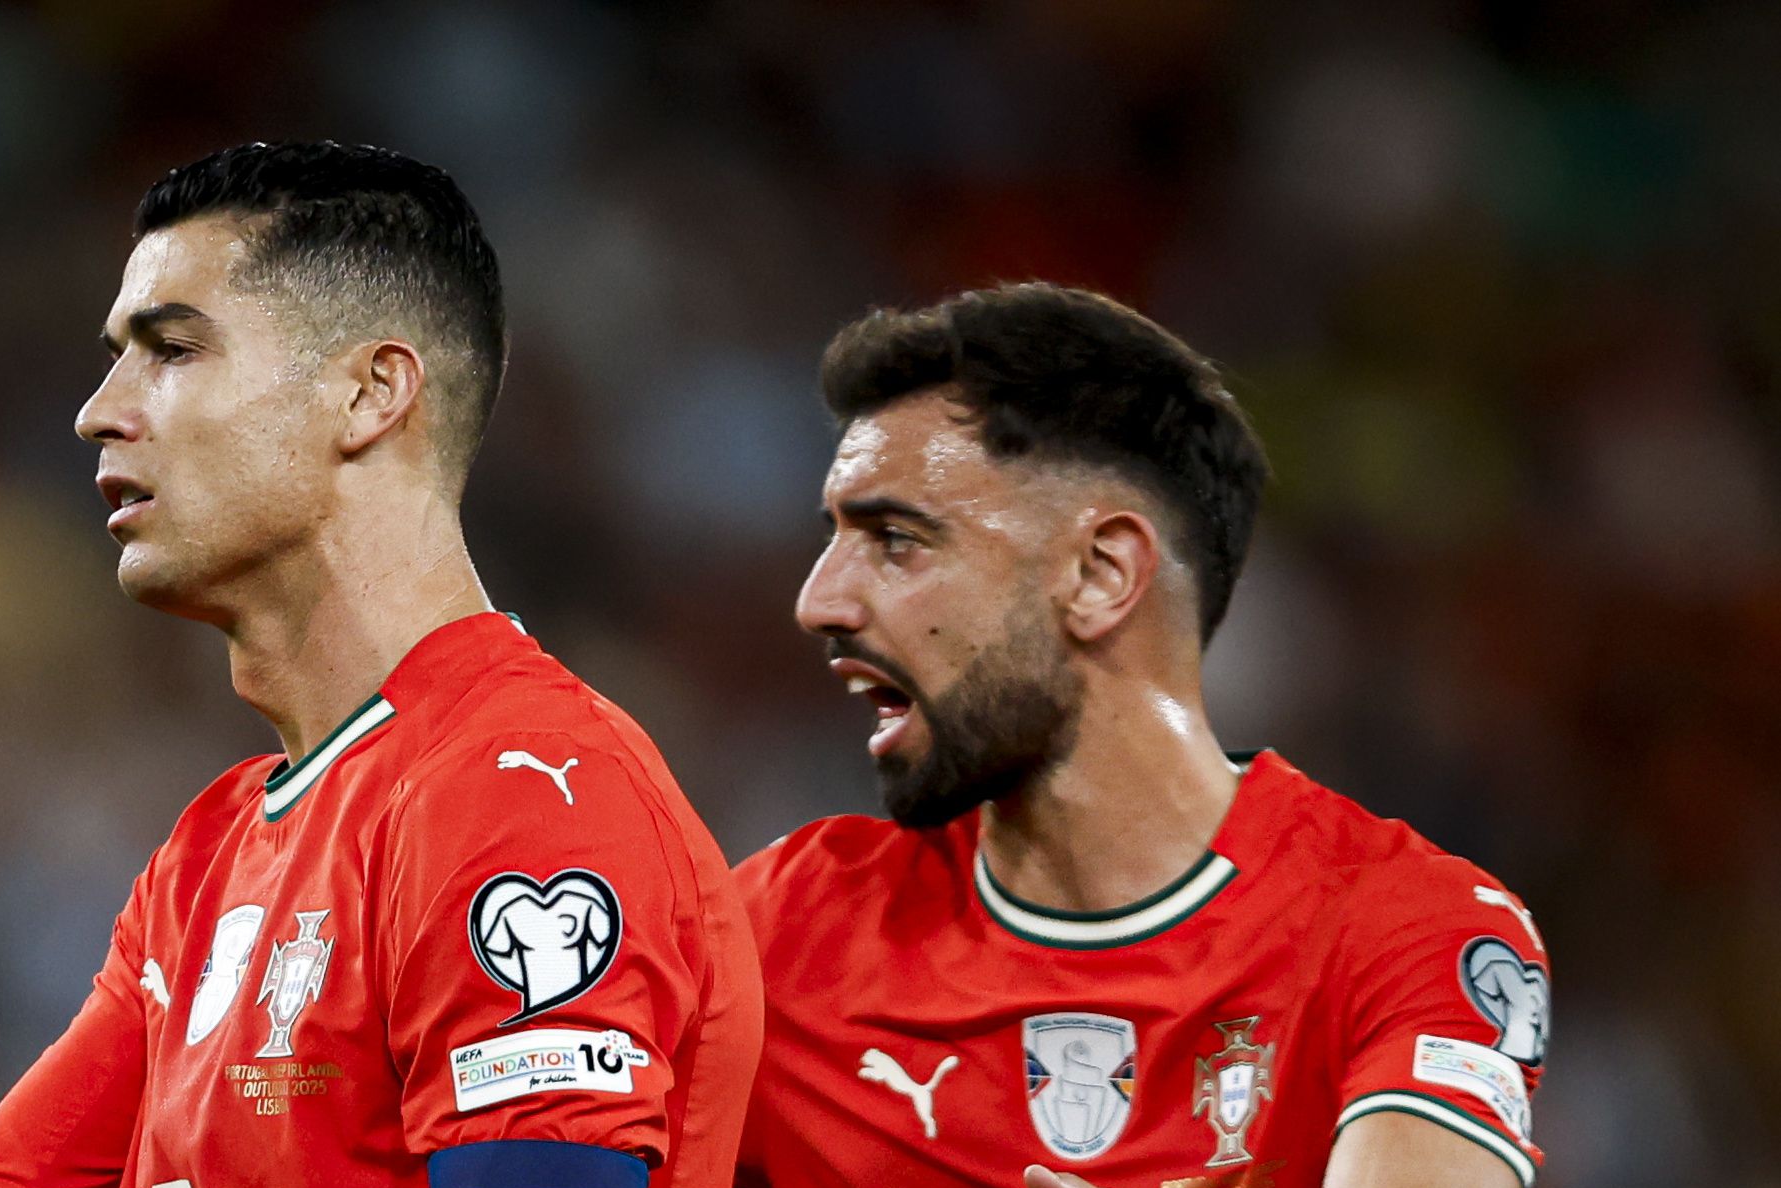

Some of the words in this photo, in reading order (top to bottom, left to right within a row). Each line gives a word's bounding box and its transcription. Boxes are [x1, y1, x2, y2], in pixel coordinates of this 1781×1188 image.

[456, 1048, 483, 1064] UEFA
[458, 1052, 575, 1086] FOUNDATION
[578, 1043, 623, 1074] 10
[225, 1064, 270, 1080] PORTUGA
[292, 1079, 328, 1096] 2025
[530, 1076, 542, 1090] for
[543, 1073, 577, 1084] children
